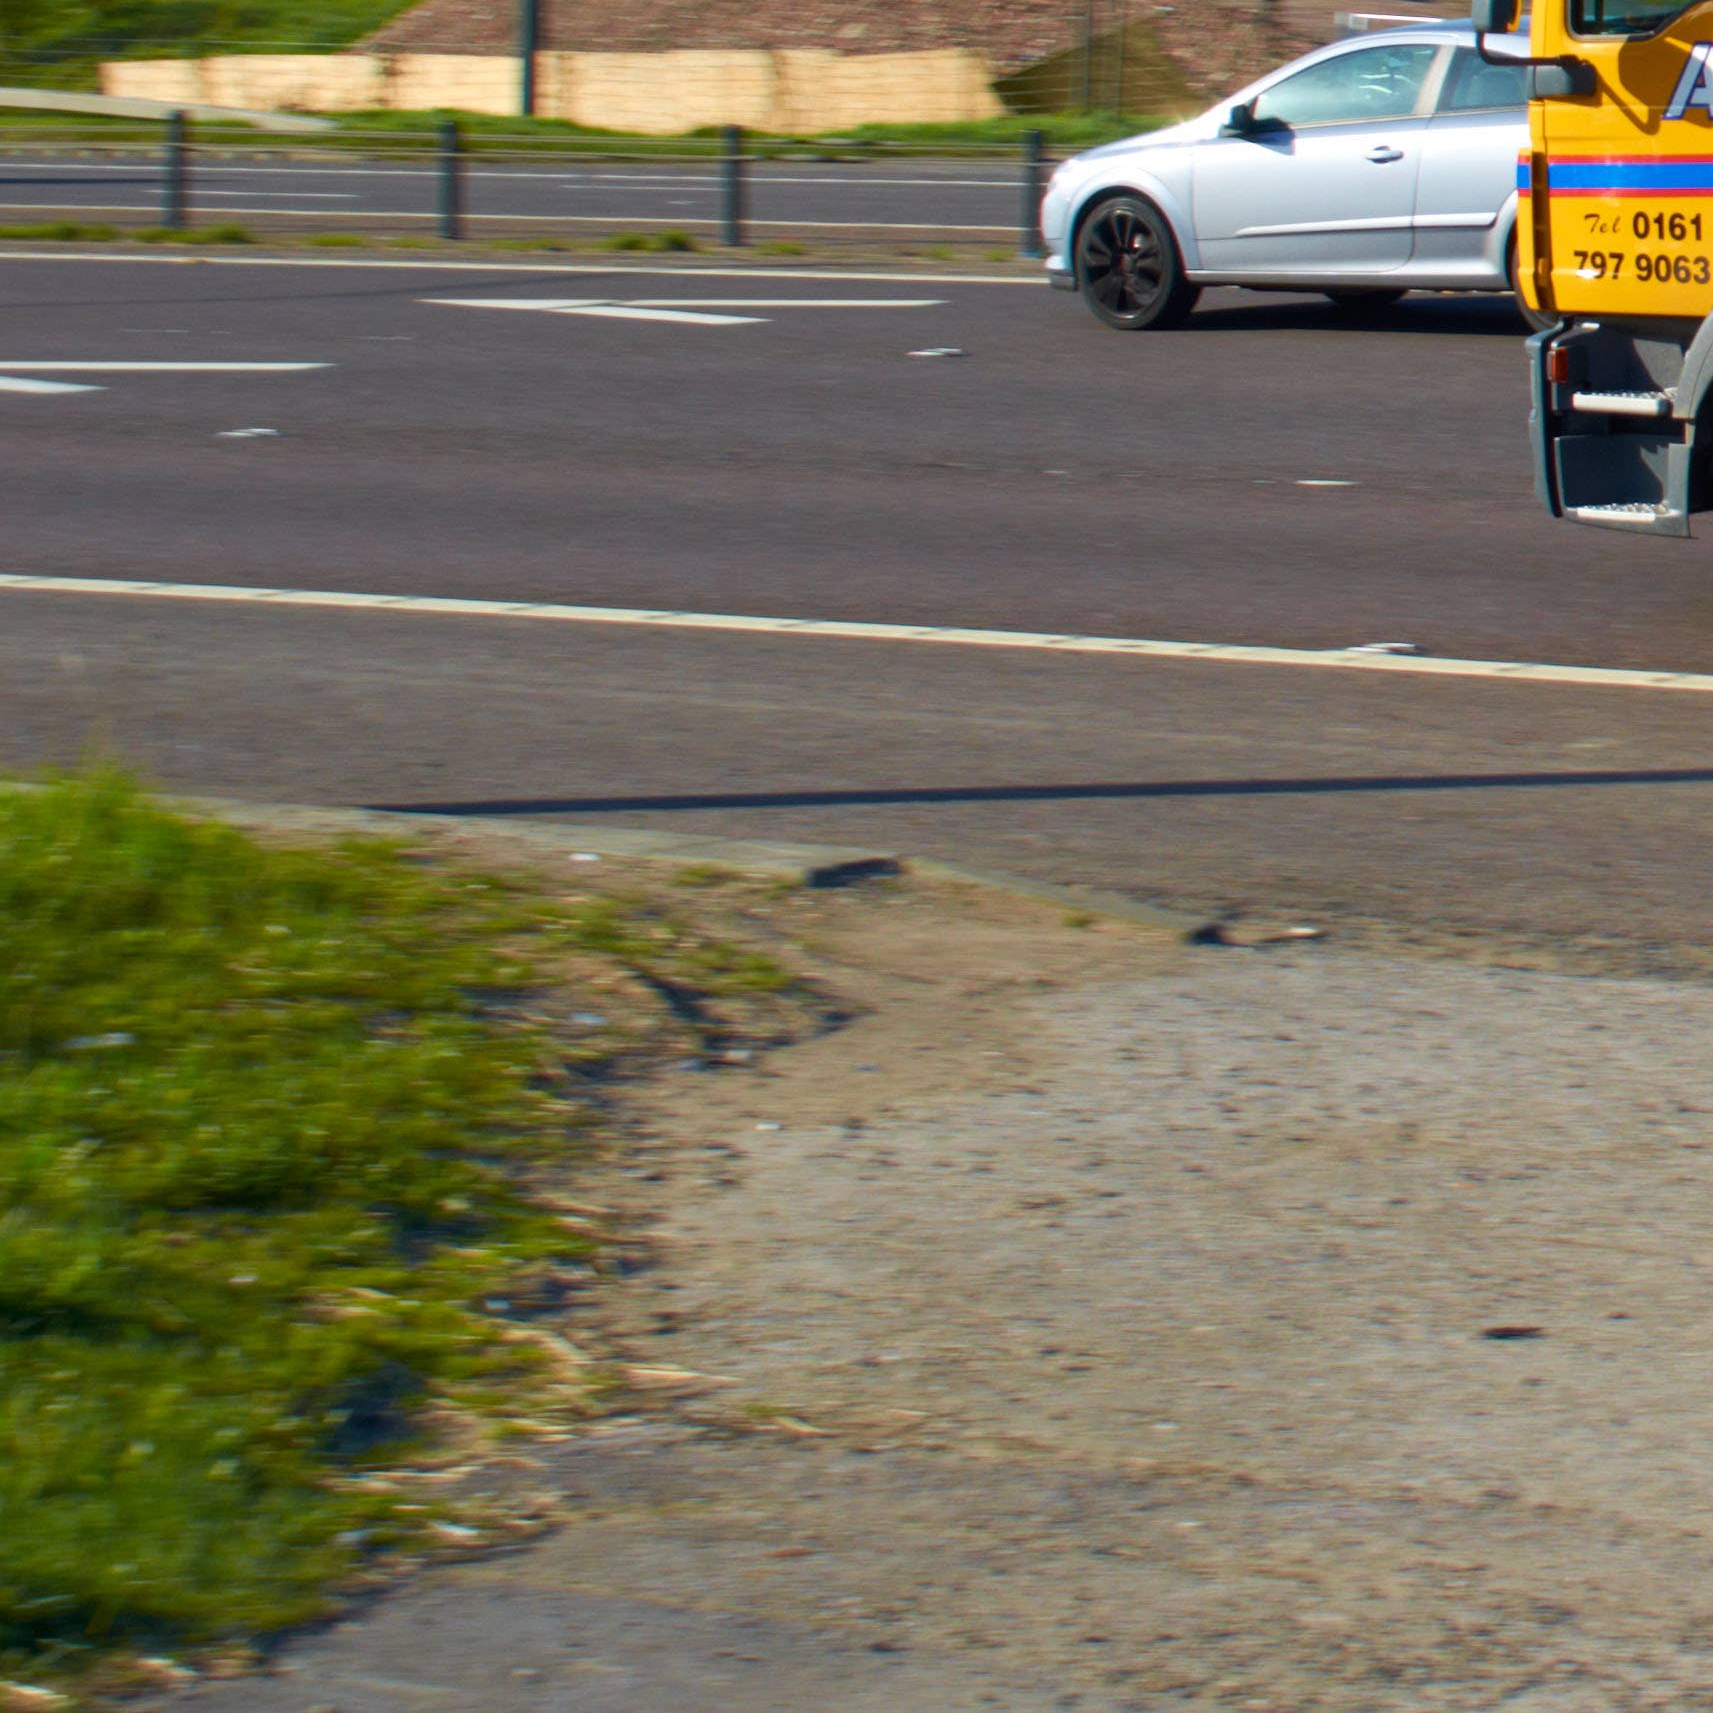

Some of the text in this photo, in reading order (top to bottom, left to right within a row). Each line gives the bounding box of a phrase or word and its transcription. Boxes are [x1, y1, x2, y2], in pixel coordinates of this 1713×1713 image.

[1584, 211, 1702, 241] Tel 0161
[1573, 250, 1711, 284] 797 9063
